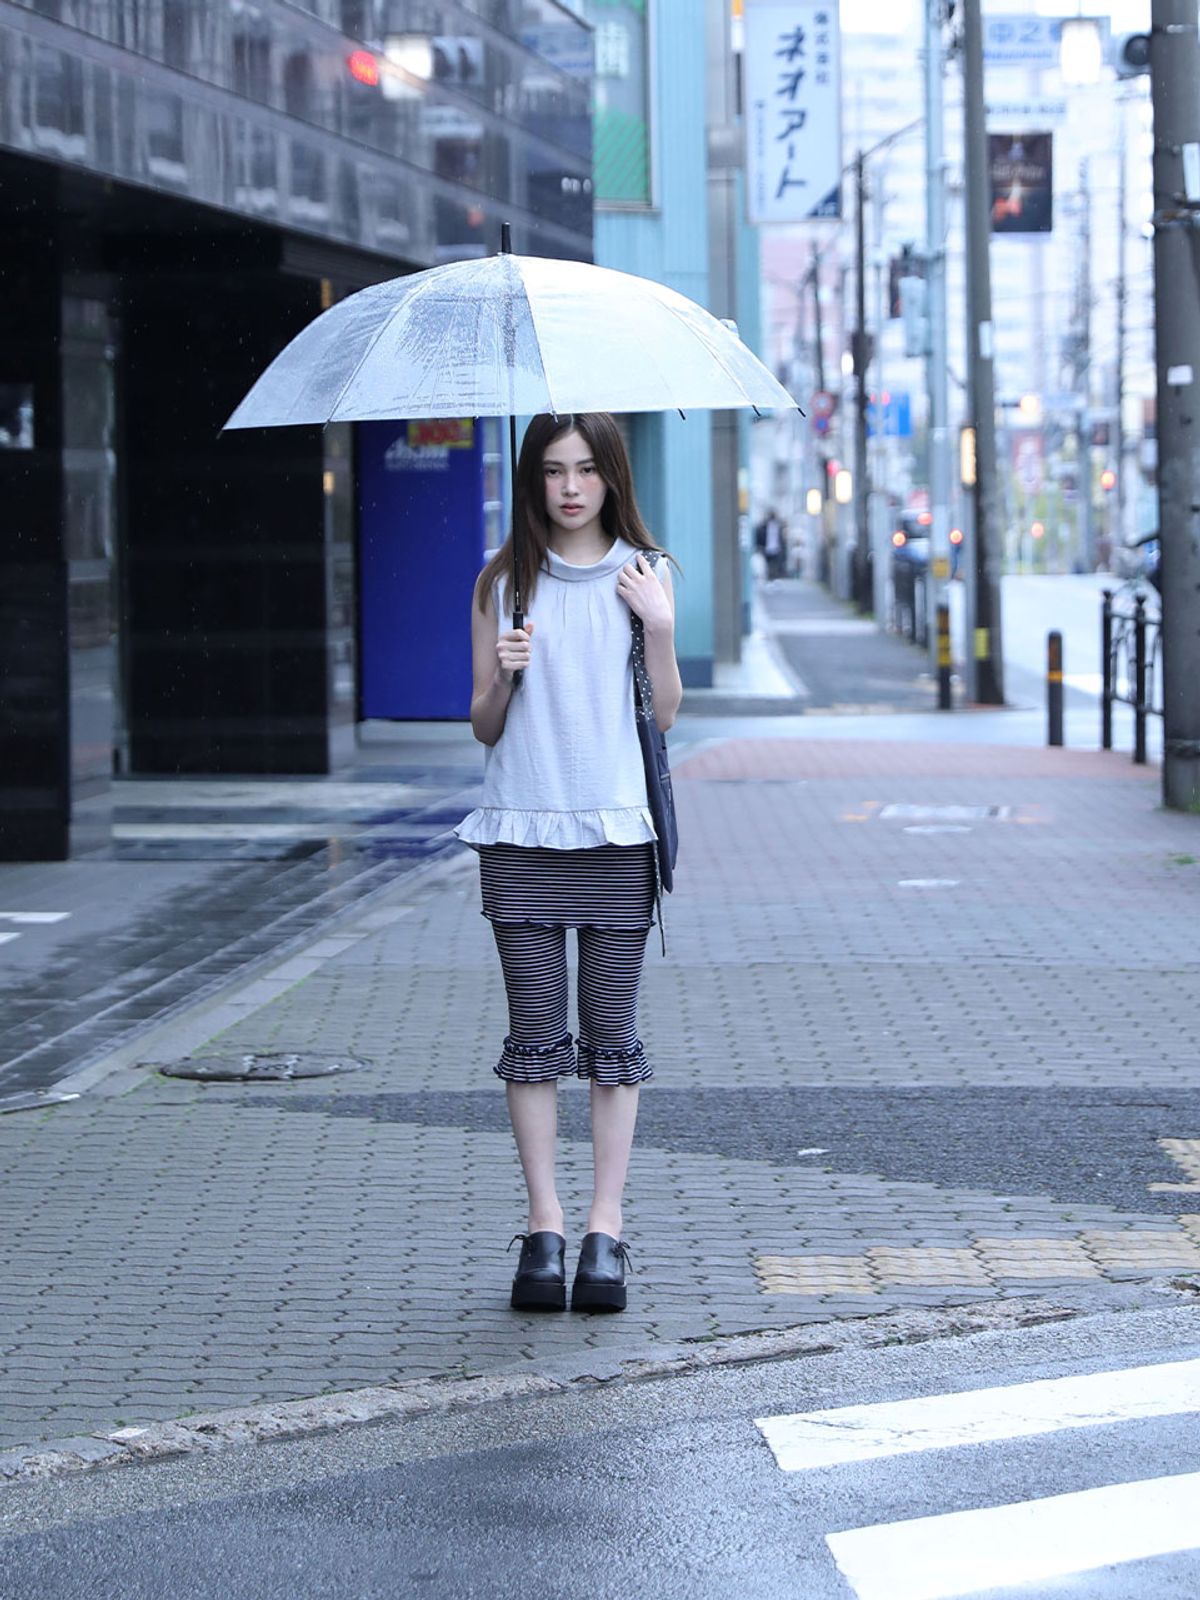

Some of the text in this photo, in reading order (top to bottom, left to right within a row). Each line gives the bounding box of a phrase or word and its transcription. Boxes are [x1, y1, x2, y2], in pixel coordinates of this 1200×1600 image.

[774, 24, 807, 200] ネオアート
